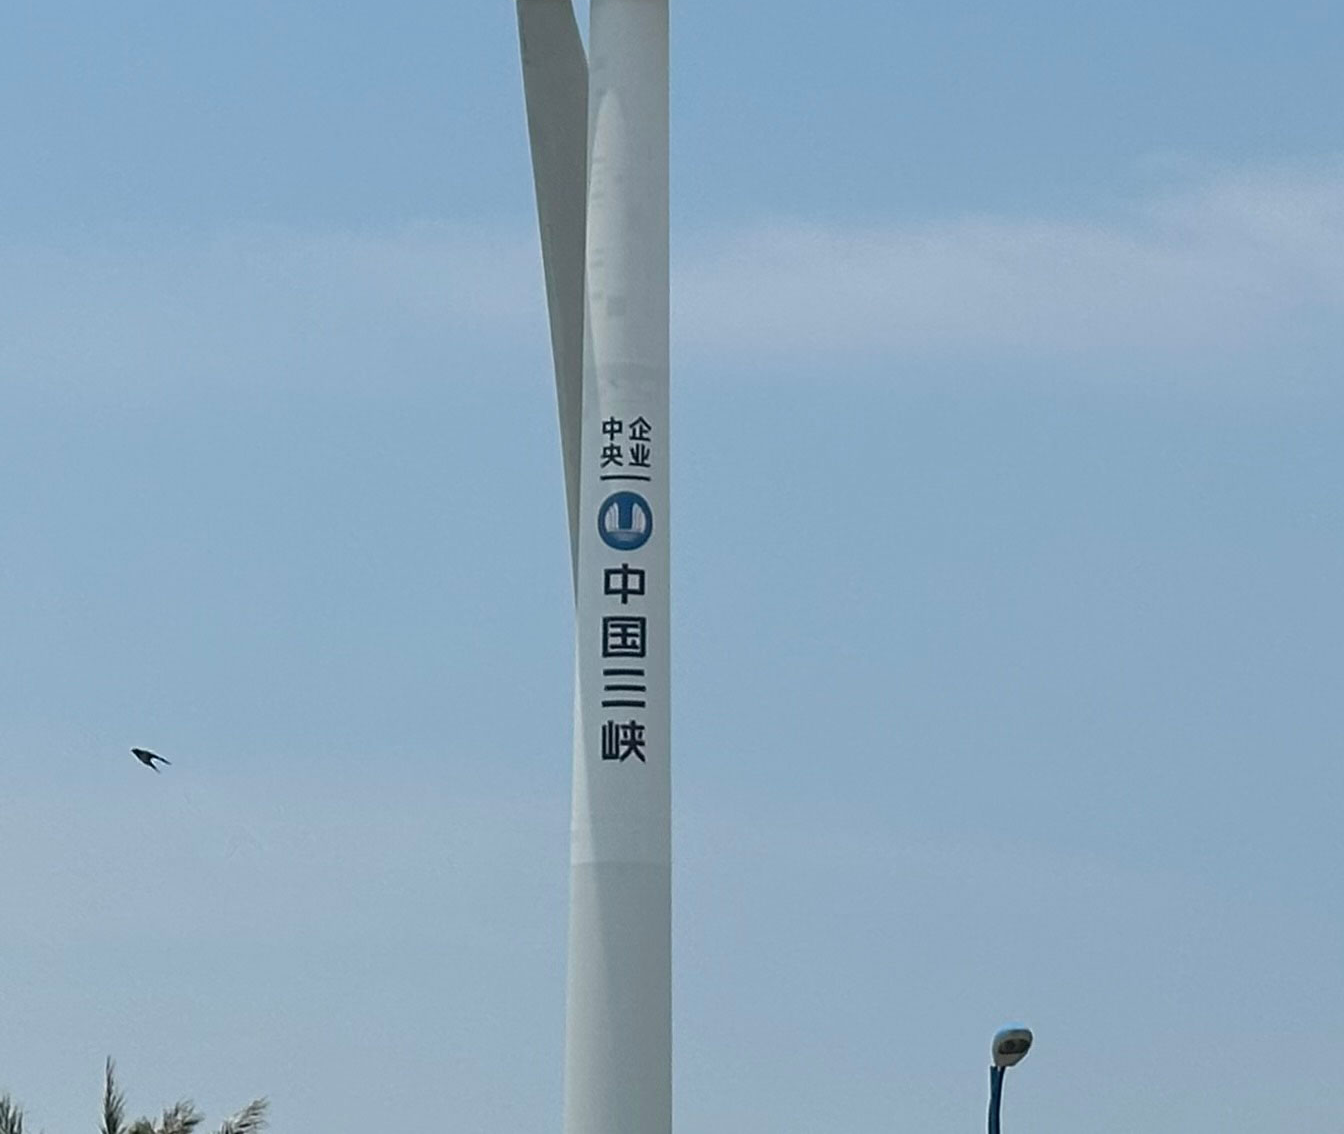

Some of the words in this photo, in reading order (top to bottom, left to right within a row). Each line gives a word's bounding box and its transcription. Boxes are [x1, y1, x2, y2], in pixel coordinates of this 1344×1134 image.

[600, 416, 624, 468] 中央
[628, 416, 652, 468] 企业
[601, 563, 647, 763] 中国三峡
